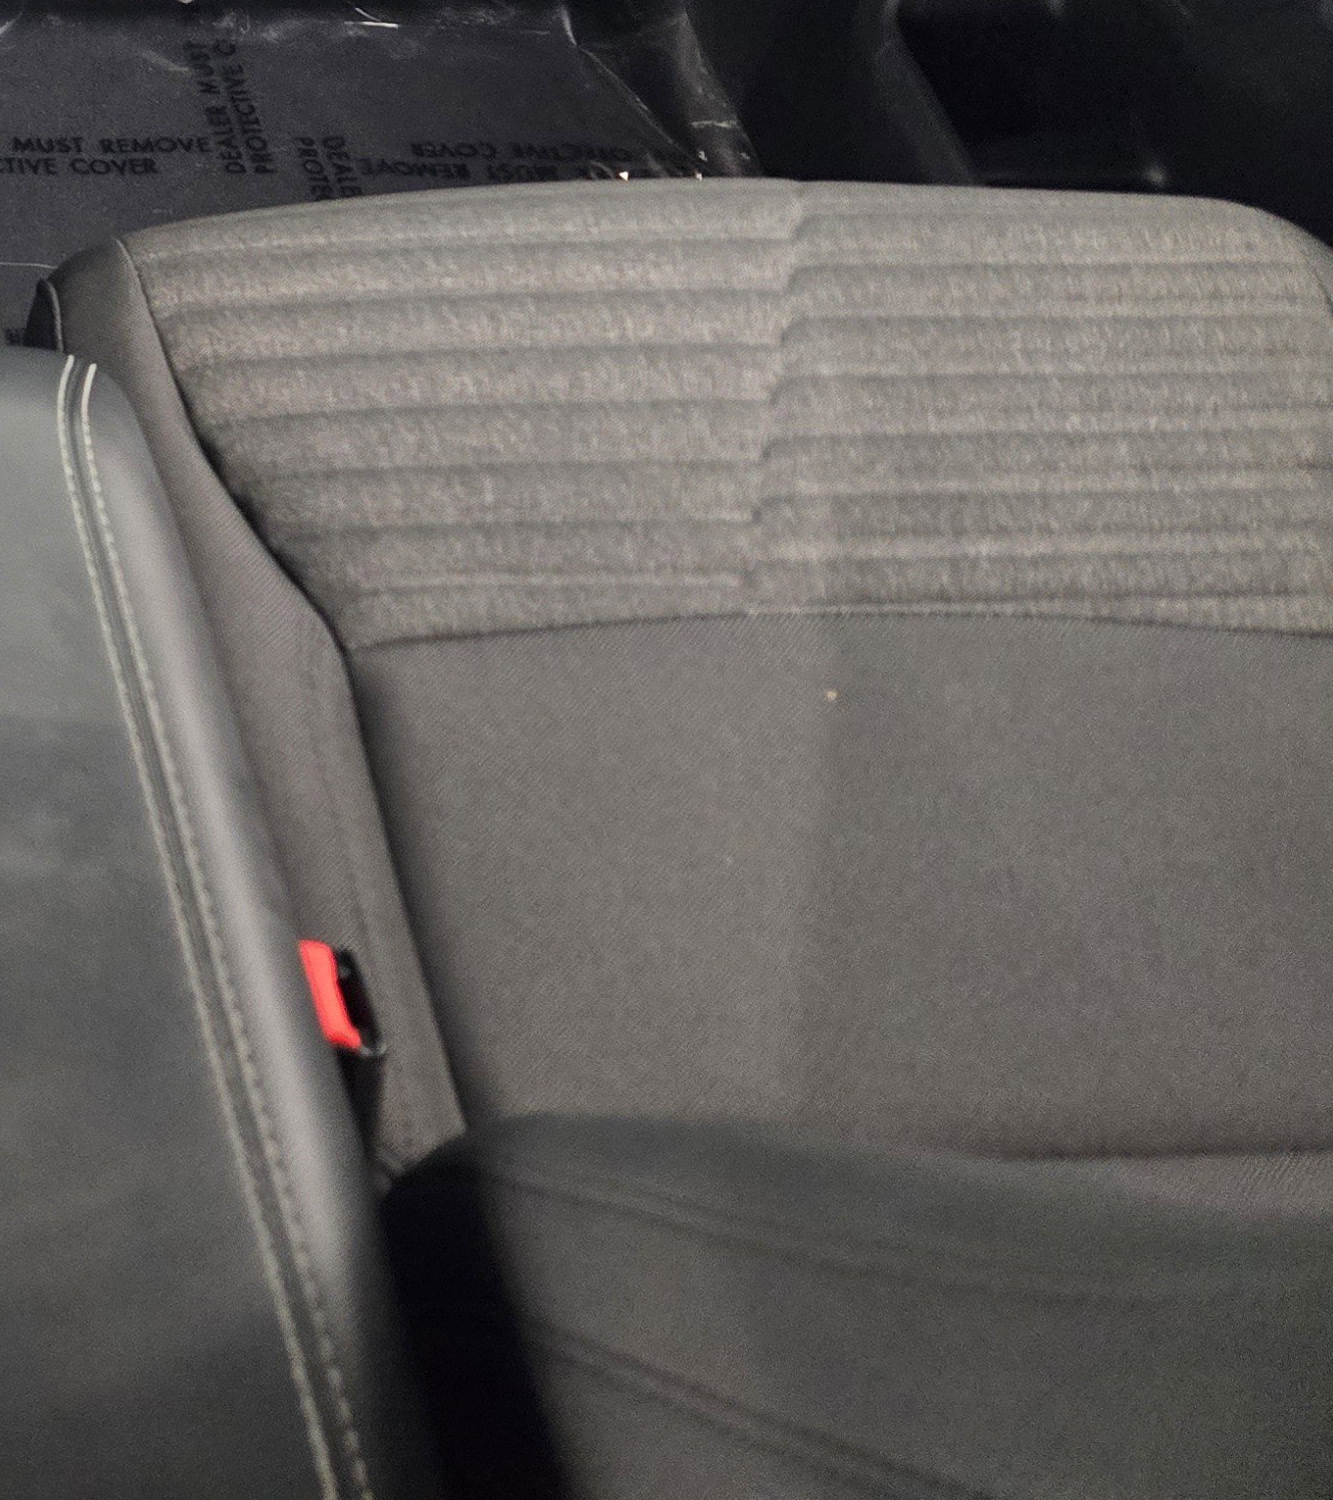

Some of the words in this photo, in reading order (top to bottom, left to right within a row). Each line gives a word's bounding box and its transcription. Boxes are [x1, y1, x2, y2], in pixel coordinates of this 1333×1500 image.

[12, 135, 85, 154] MUST
[99, 135, 212, 154] REMOVE
[68, 156, 160, 177] COVER
